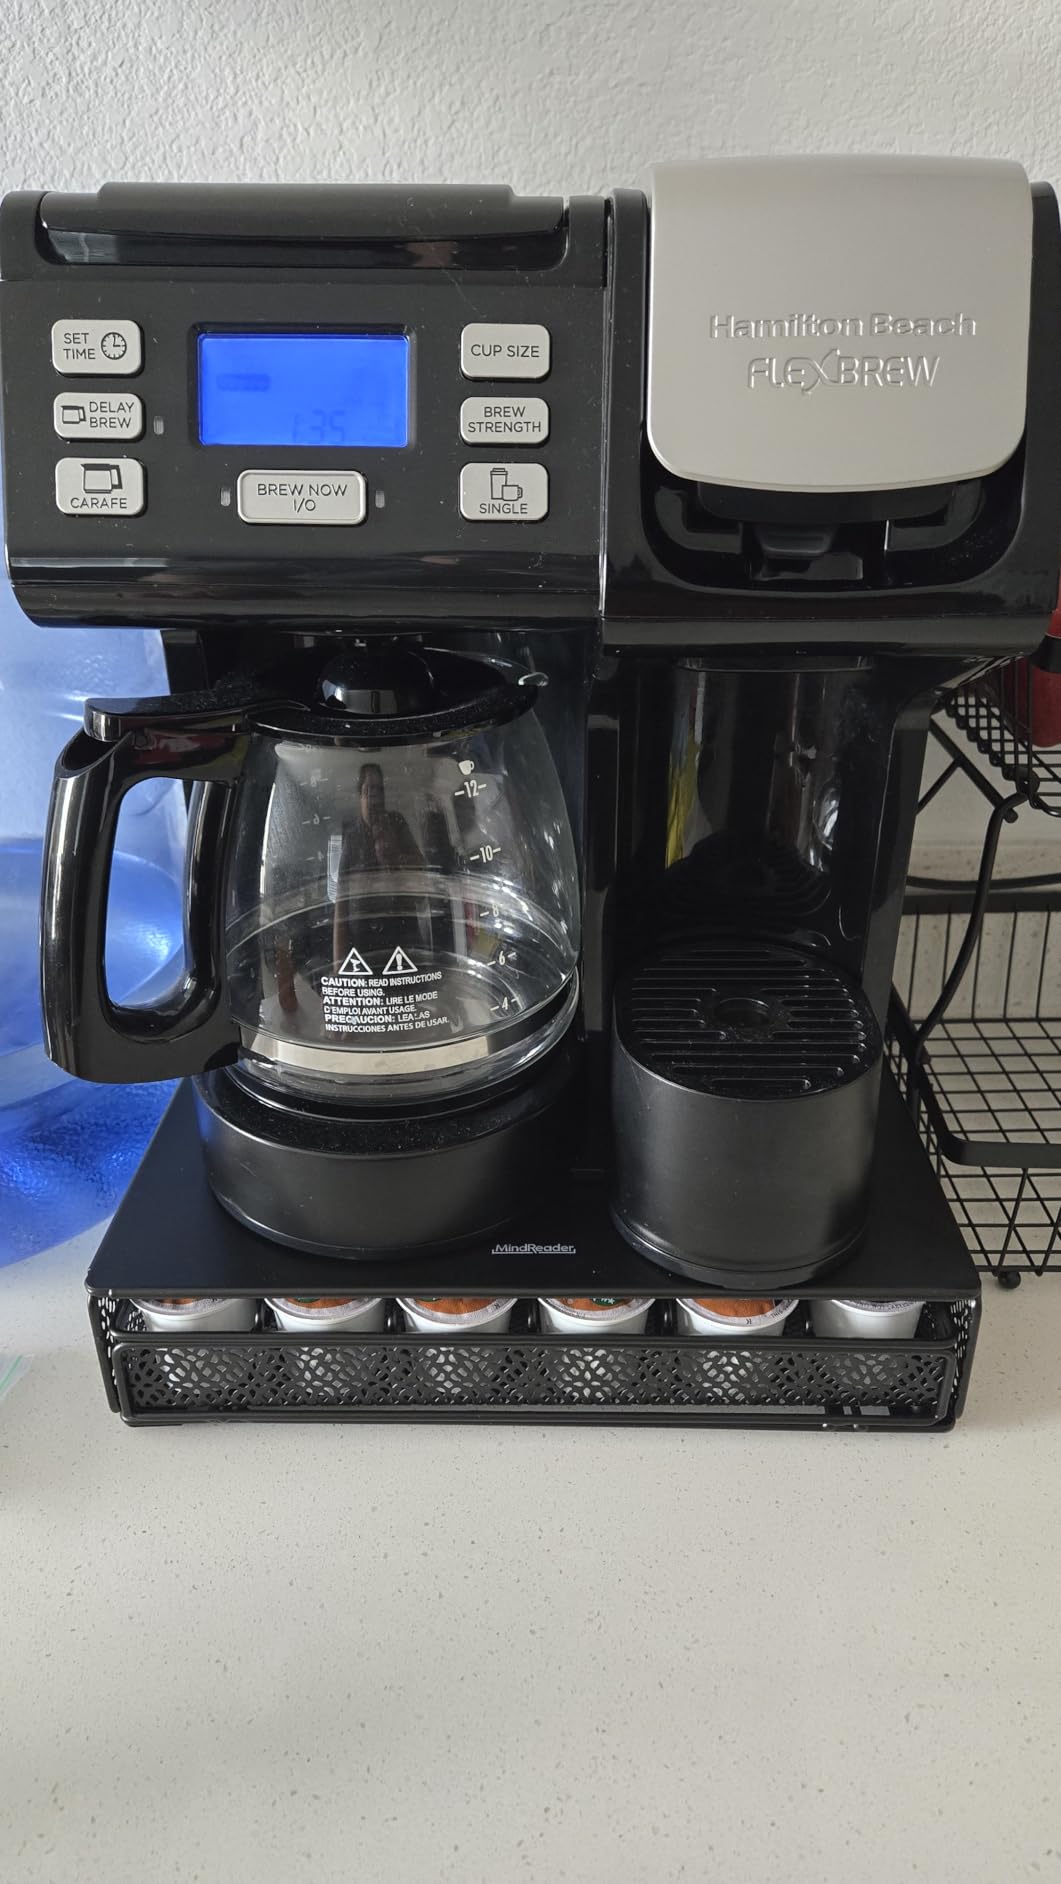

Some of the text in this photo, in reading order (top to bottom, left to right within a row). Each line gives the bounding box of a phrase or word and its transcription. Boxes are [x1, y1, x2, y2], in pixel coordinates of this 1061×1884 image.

[710, 312, 977, 339] Hamilton Beach
[63, 332, 90, 345] SET
[63, 348, 96, 360] TIME
[470, 343, 540, 358] CUP SIZE
[747, 348, 941, 393] FLEXBREW
[89, 401, 135, 413] DELAY
[483, 406, 526, 418] BREW
[89, 417, 132, 428] BREW
[467, 421, 541, 433] STRENGTH
[257, 483, 348, 497] BREW NOW
[70, 497, 128, 509] CARAFE
[293, 498, 316, 513] I/O
[479, 503, 528, 514] SINGLE
[320, 971, 442, 987] CAUTION: READ INSTRUCTIONS
[322, 987, 385, 997] BEFORE USING.
[323, 991, 438, 1006] ATTENTION: LIRE LE MODE
[361, 1006, 387, 1015] AVANT
[325, 1023, 386, 1032] INSTRUCCIONES
[387, 1022, 414, 1032] ANTES
[415, 1020, 426, 1030] DE
[493, 1242, 576, 1254] MindReader
